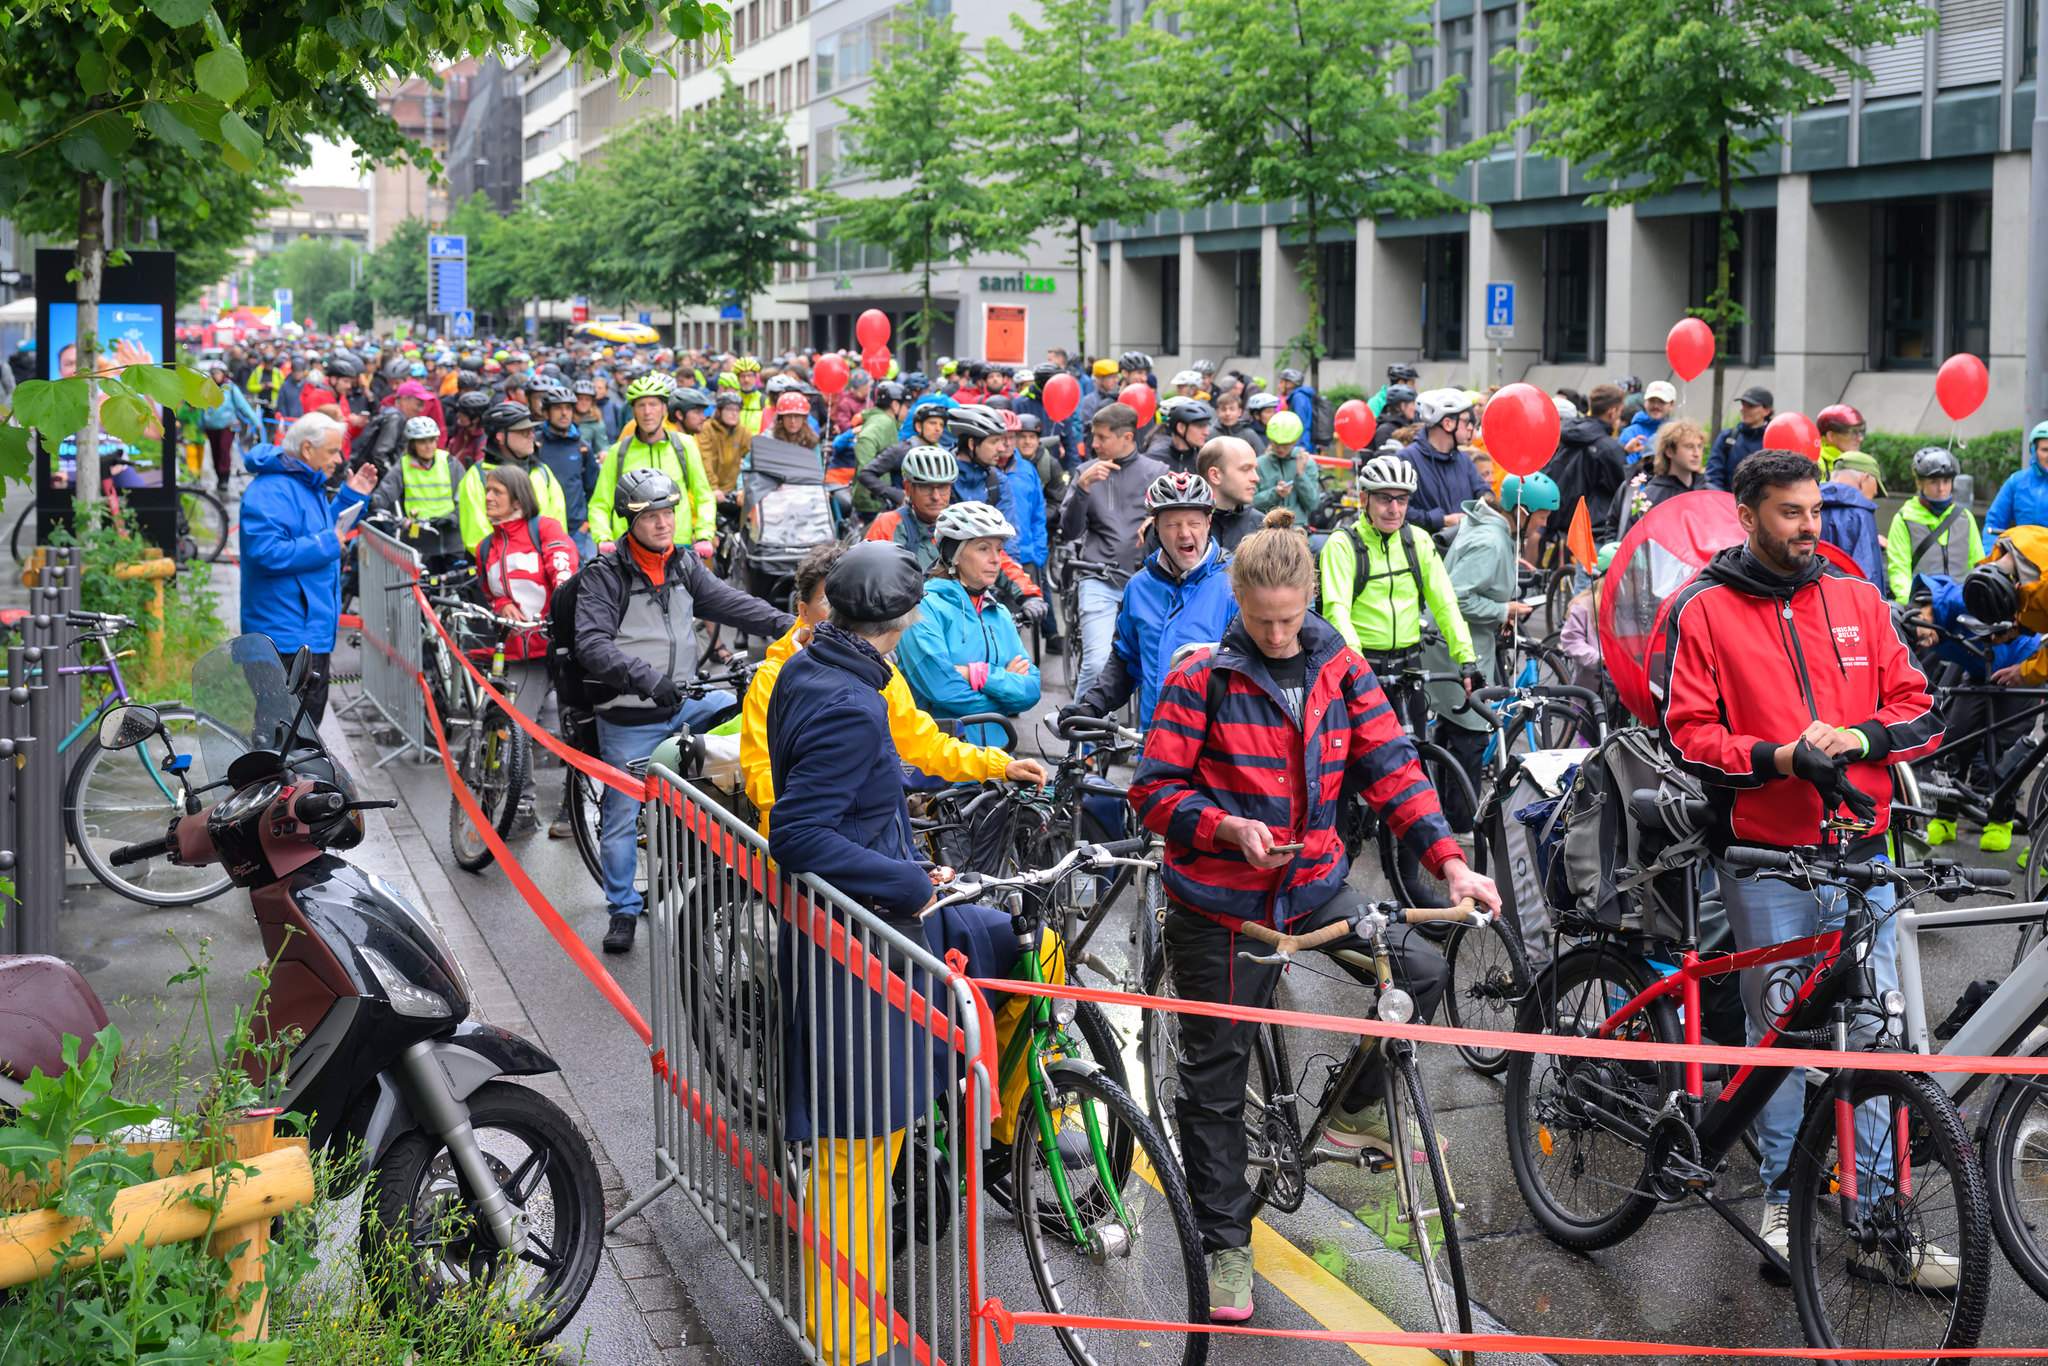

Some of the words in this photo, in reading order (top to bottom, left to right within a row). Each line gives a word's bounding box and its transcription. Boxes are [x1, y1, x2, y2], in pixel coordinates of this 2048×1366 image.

[979, 271, 1057, 293] sanitas
[1495, 287, 1507, 307] P
[1831, 625, 1859, 634] CHICAGO
